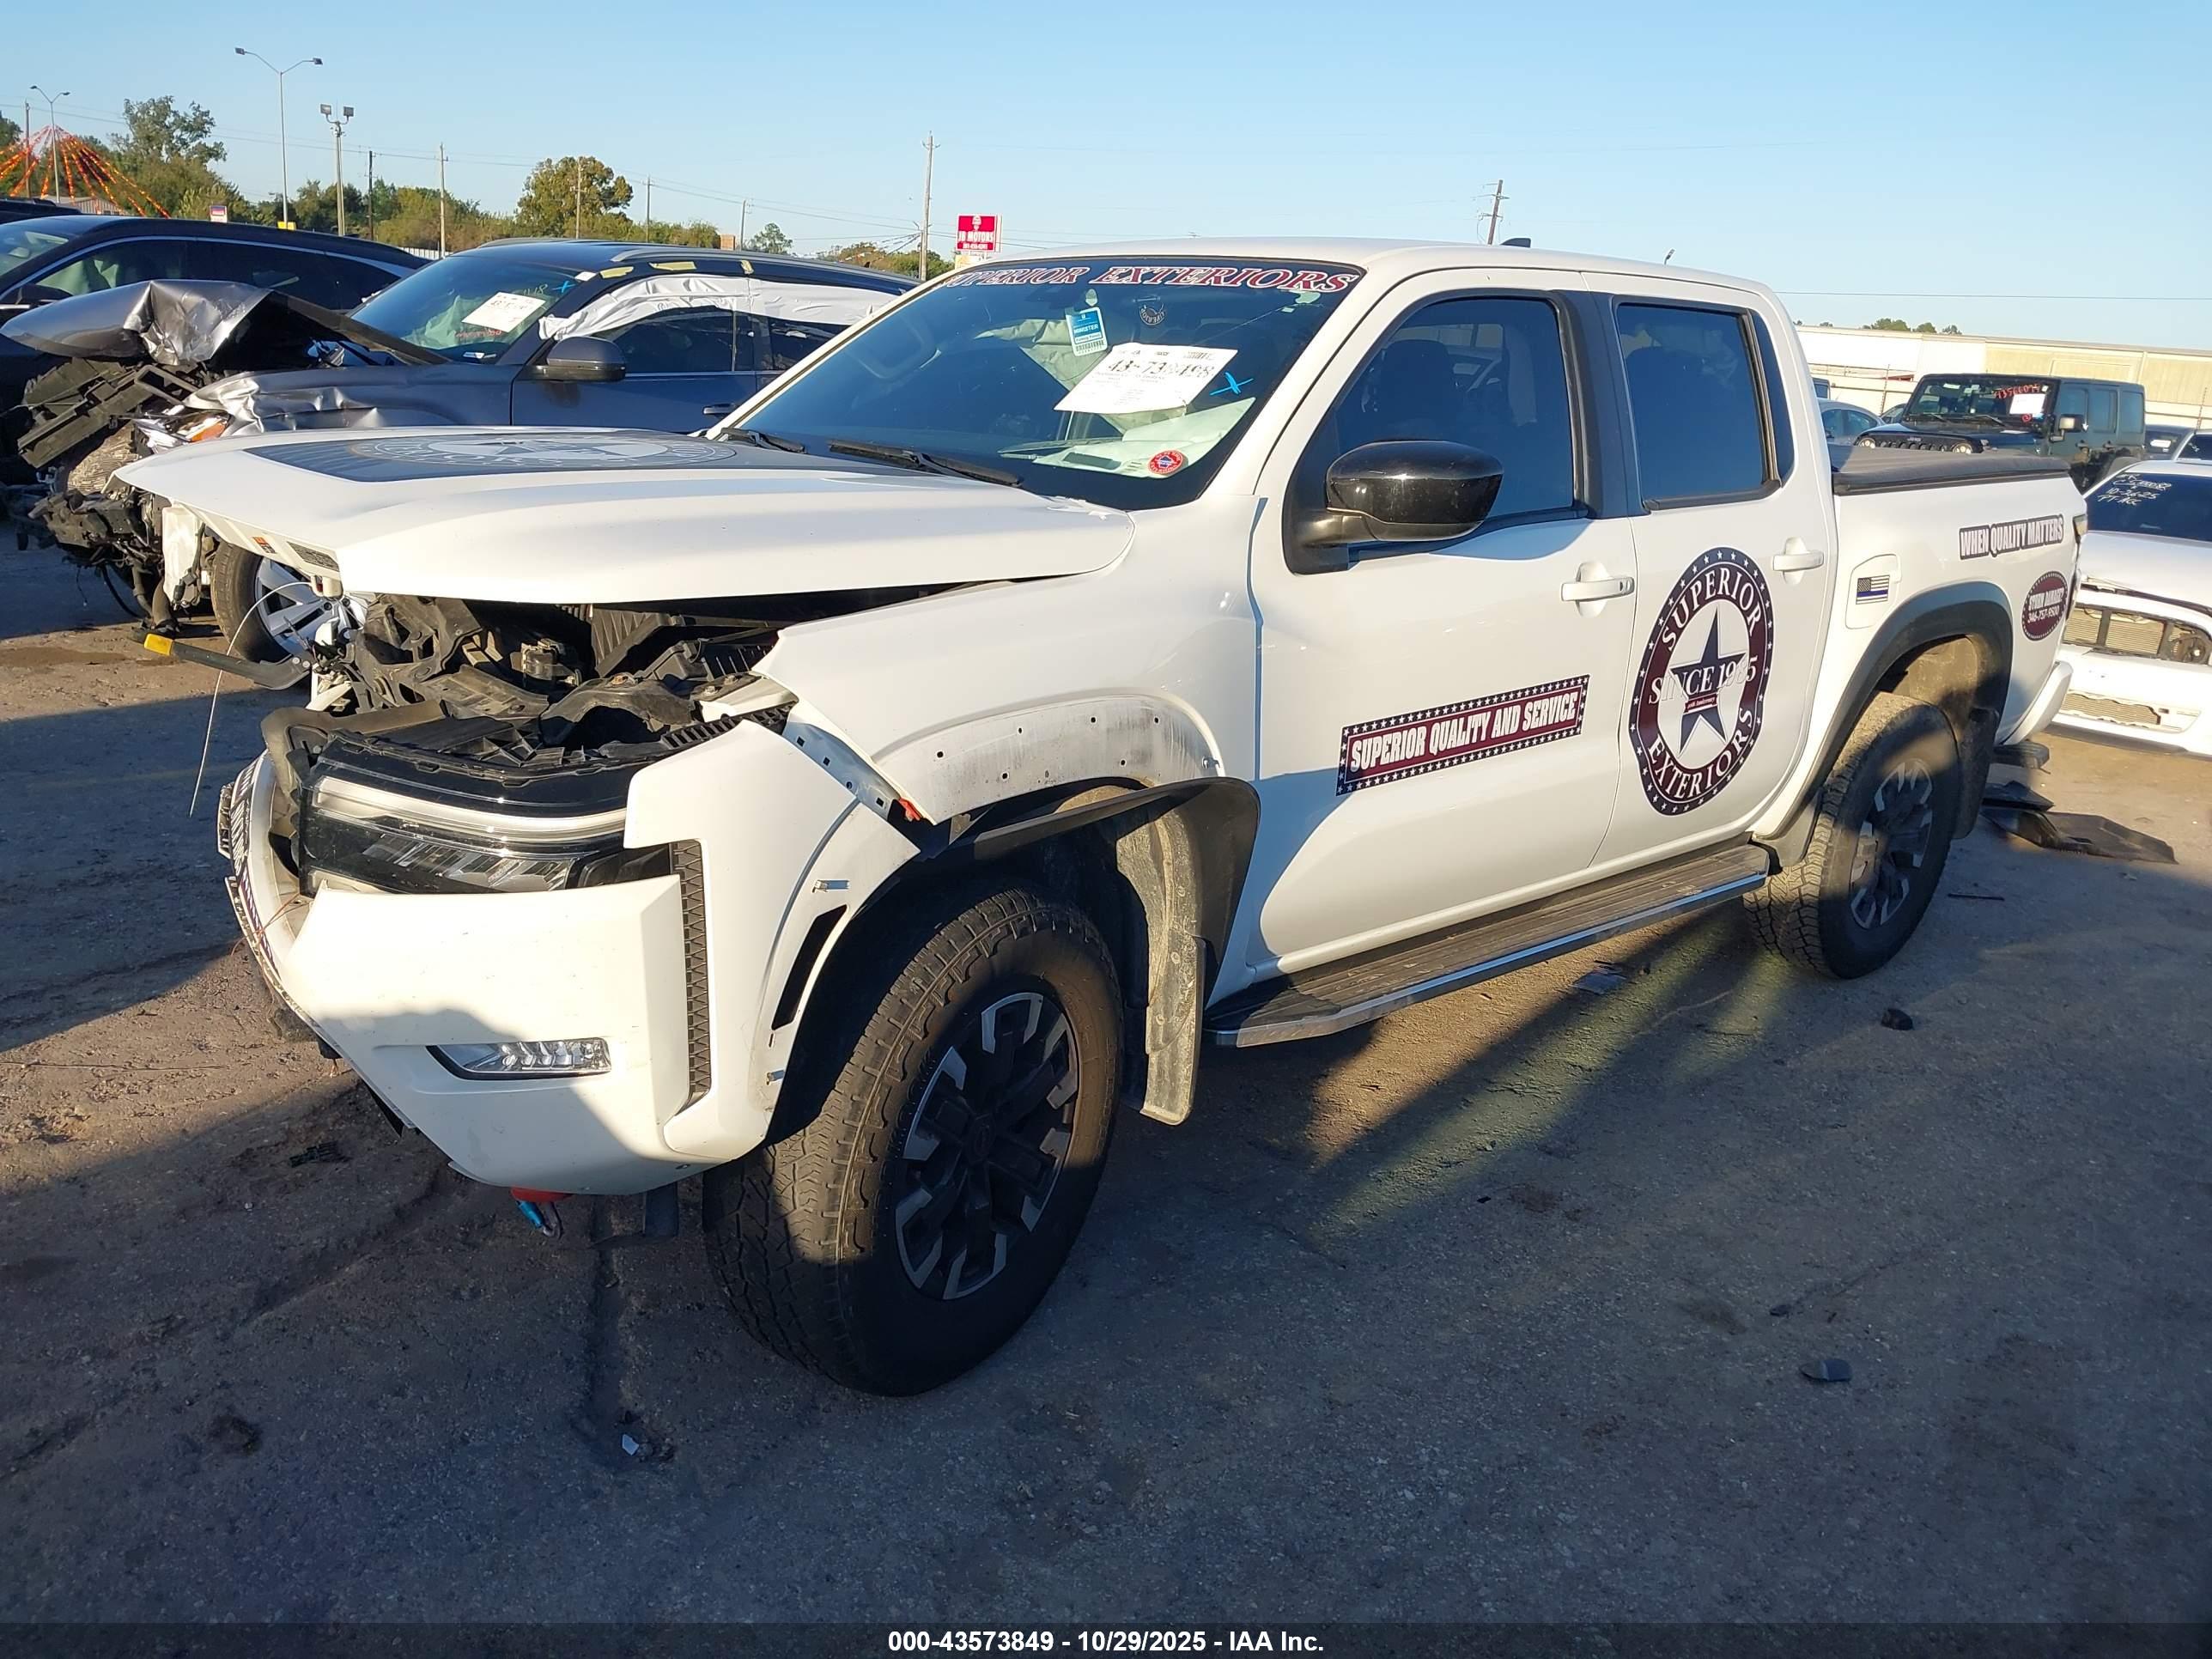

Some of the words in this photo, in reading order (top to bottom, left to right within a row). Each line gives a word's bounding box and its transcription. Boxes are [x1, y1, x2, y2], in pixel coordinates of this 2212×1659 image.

[967, 231, 994, 242] MOTORS
[1089, 266, 1359, 292] EXTERIORS
[1960, 528, 1990, 556] WHEN
[1990, 523, 2027, 555] QUALITY
[2027, 517, 2063, 545] MATTERS
[1662, 568, 1761, 651] SUPERIOR
[1649, 666, 1714, 704] SINCE
[1717, 657, 1758, 689] 1985
[1351, 726, 1427, 772] SUPERIOR
[1429, 711, 1492, 756] QUALITY
[1491, 705, 1522, 738] AND
[1522, 691, 1578, 731] SERVICE
[1648, 708, 1753, 799] EXTERIORS
